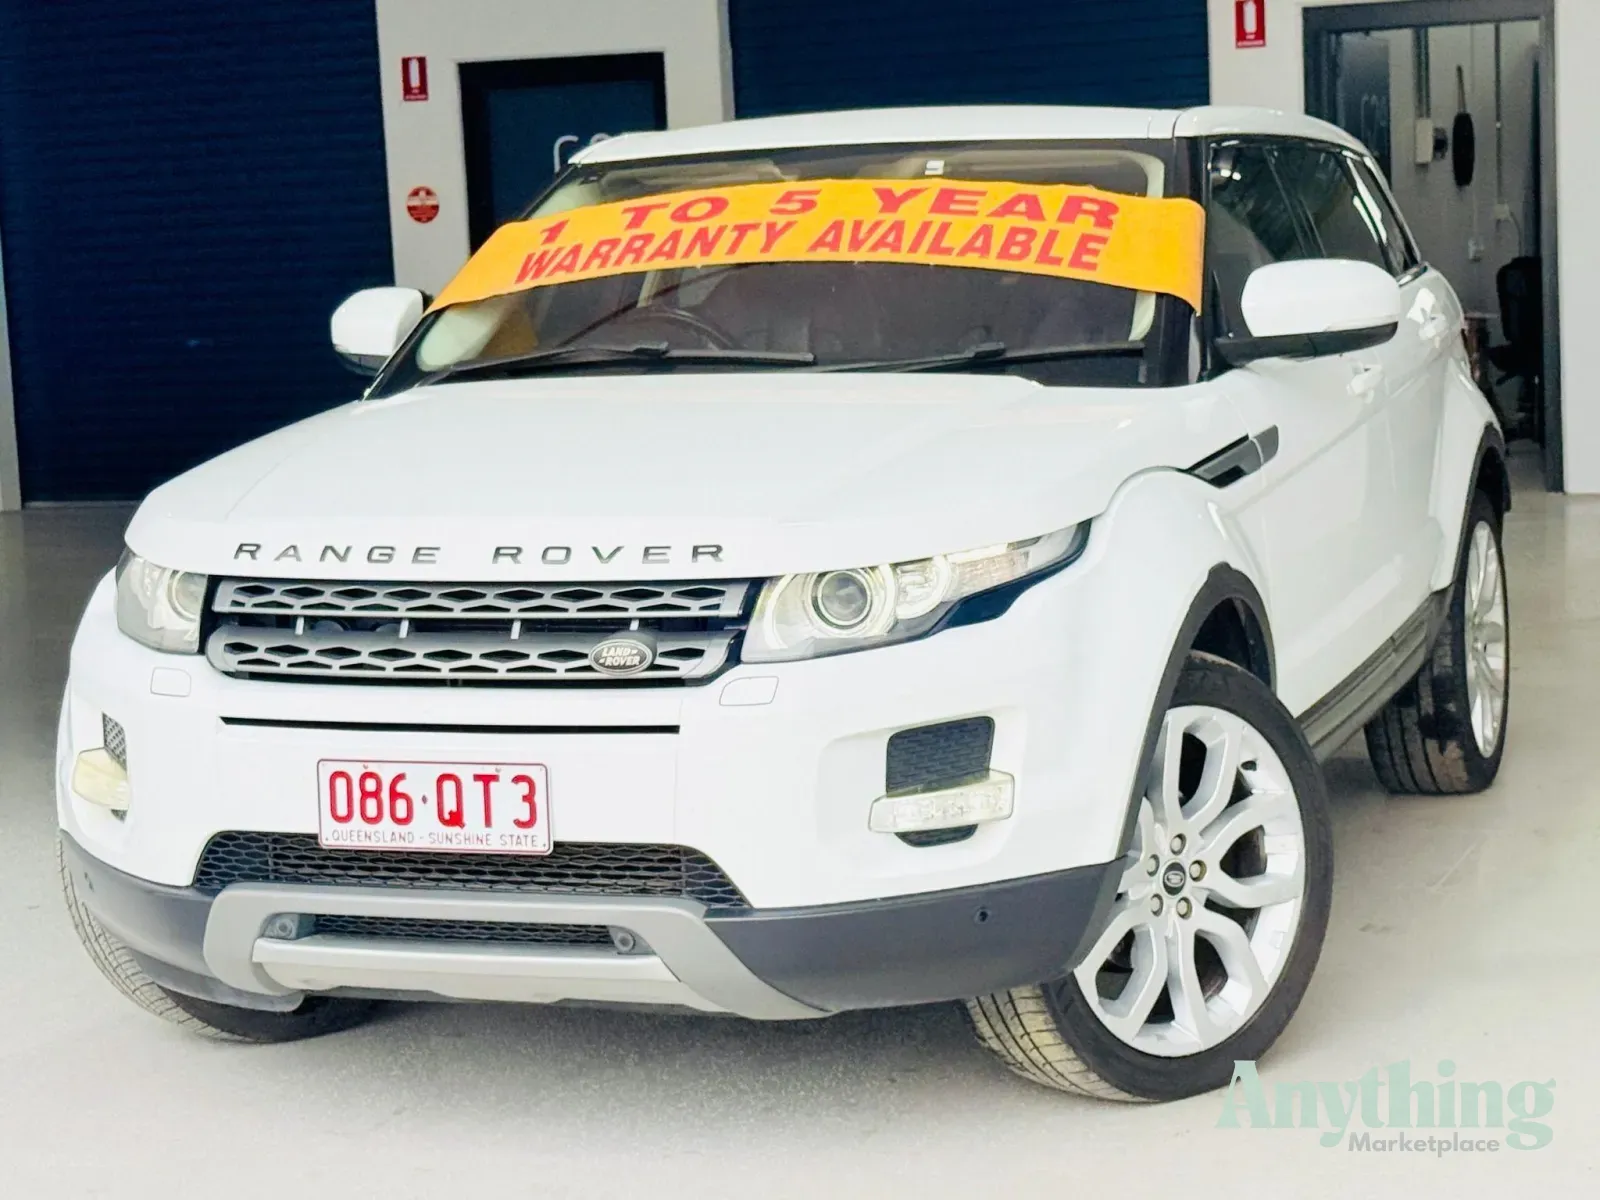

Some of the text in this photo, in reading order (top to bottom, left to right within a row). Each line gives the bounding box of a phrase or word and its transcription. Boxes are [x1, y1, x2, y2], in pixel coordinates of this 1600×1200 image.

[540, 187, 1120, 246] 1 TO 5 YEAR
[514, 219, 1109, 285] WARRANTY AVAILABLE
[233, 542, 725, 564] RANGE ROVER
[602, 647, 631, 657] LAND
[605, 656, 640, 666] ROVER
[331, 829, 415, 844] QUEENSLAND
[428, 832, 492, 846] SUNSHINE
[500, 834, 538, 848] STATE
